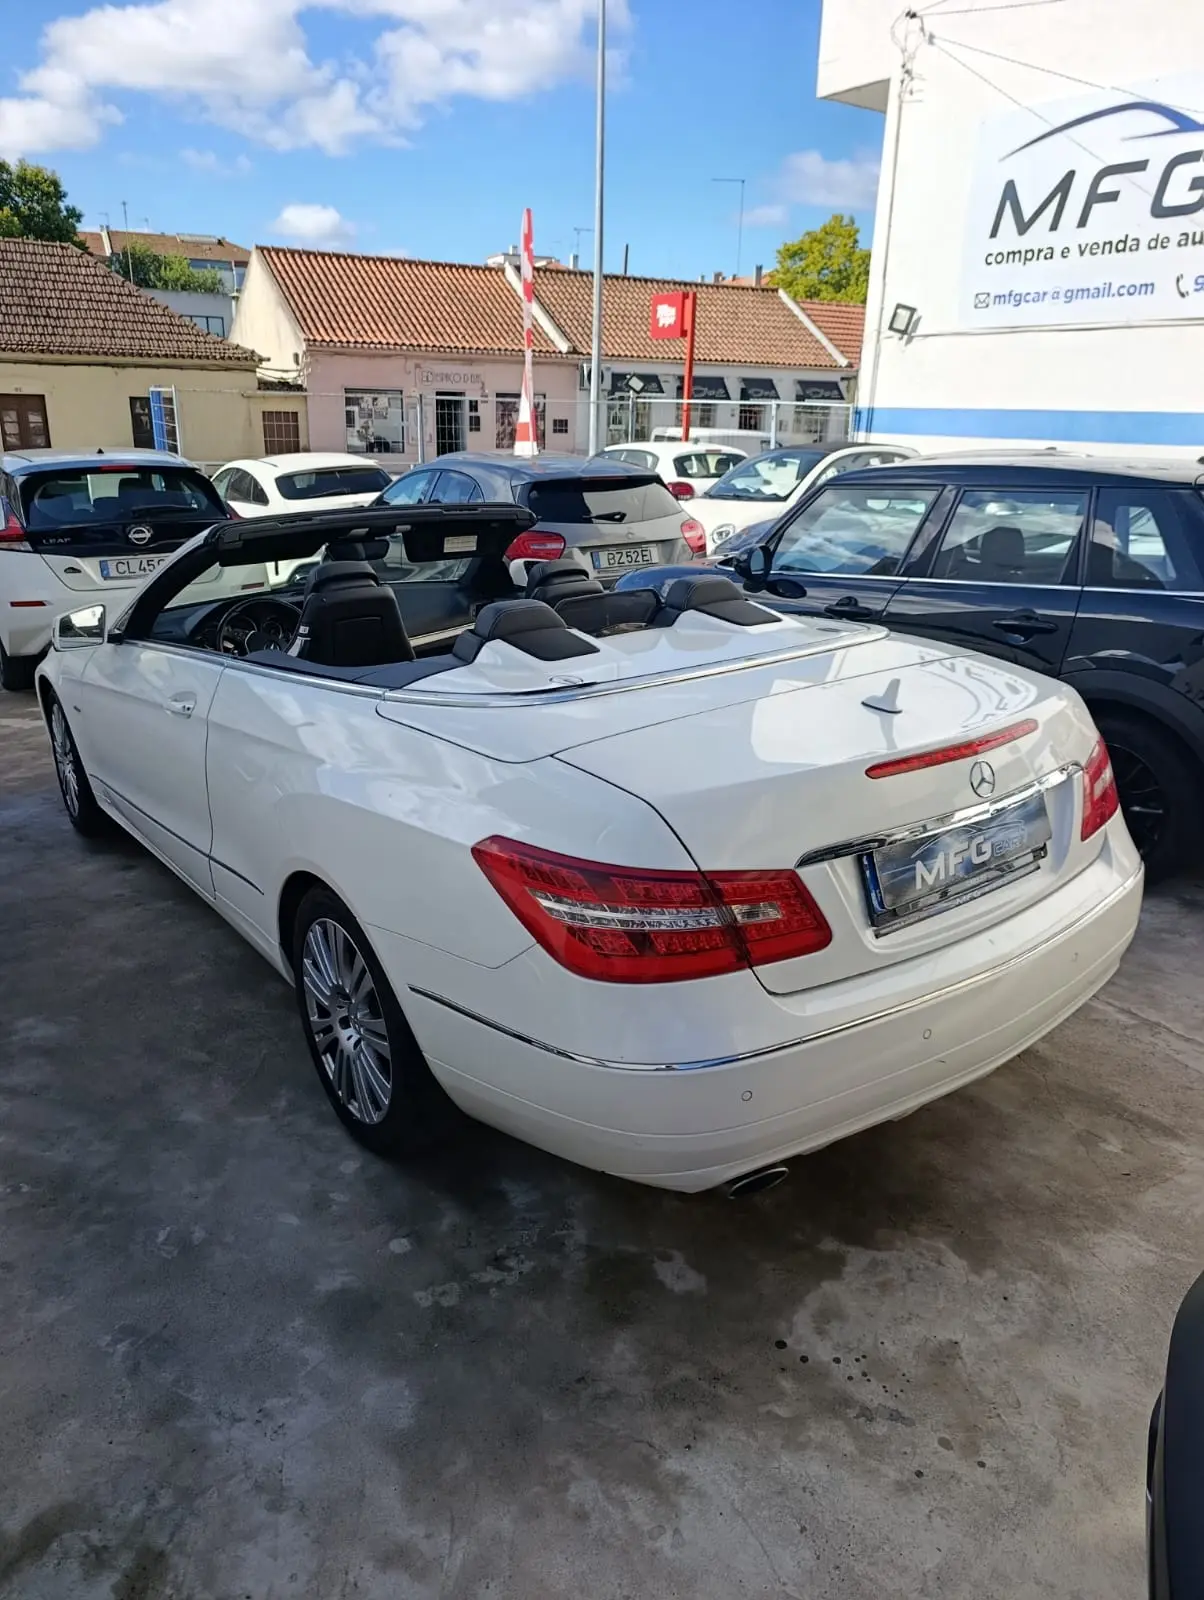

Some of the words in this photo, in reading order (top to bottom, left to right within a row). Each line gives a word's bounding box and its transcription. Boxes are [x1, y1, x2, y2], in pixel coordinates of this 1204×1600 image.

[989, 149, 1204, 239] MFG
[984, 246, 1055, 267] compra
[1060, 245, 1071, 259] e
[1078, 233, 1141, 258] venda
[1147, 233, 1171, 250] de
[115, 558, 165, 575] CL45
[914, 834, 992, 890] MFG
